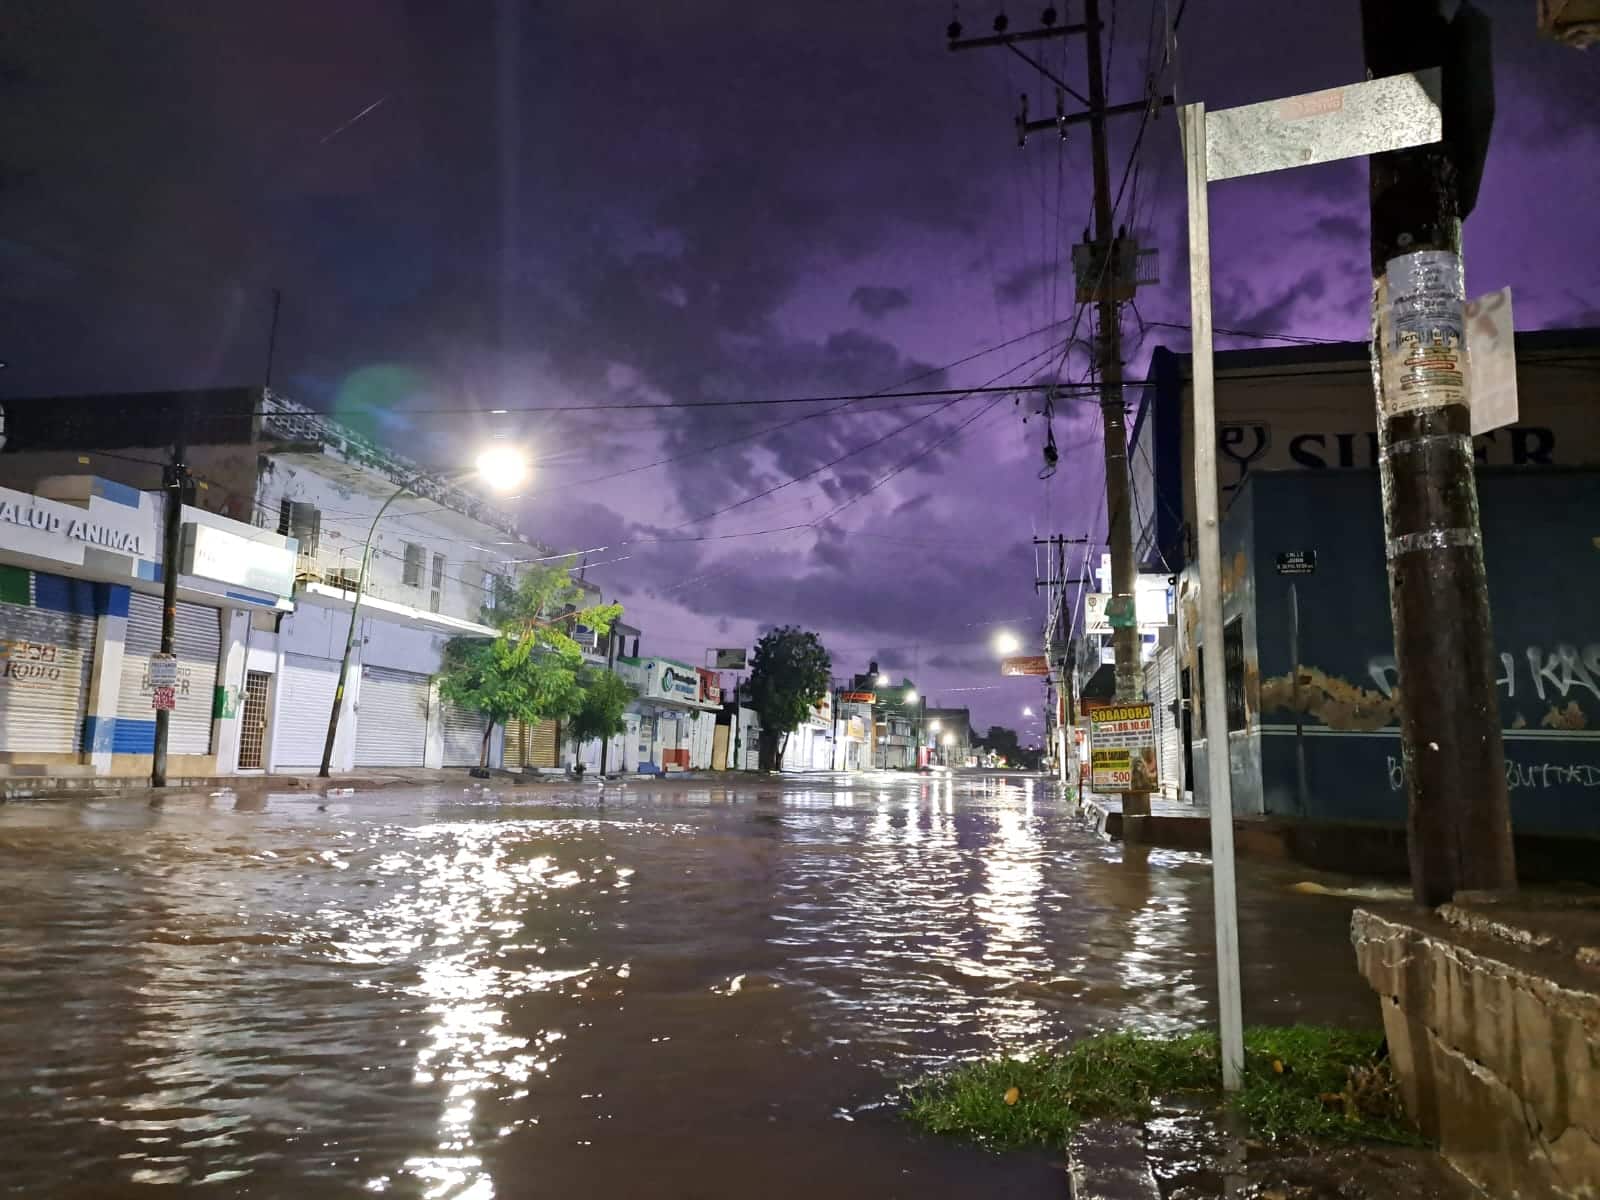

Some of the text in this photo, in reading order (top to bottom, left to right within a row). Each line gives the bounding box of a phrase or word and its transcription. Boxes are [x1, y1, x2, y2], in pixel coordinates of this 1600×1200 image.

[1289, 427, 1556, 469] SIER
[67, 518, 144, 555] ANIMAL
[1092, 706, 1151, 722] SOBADORA
